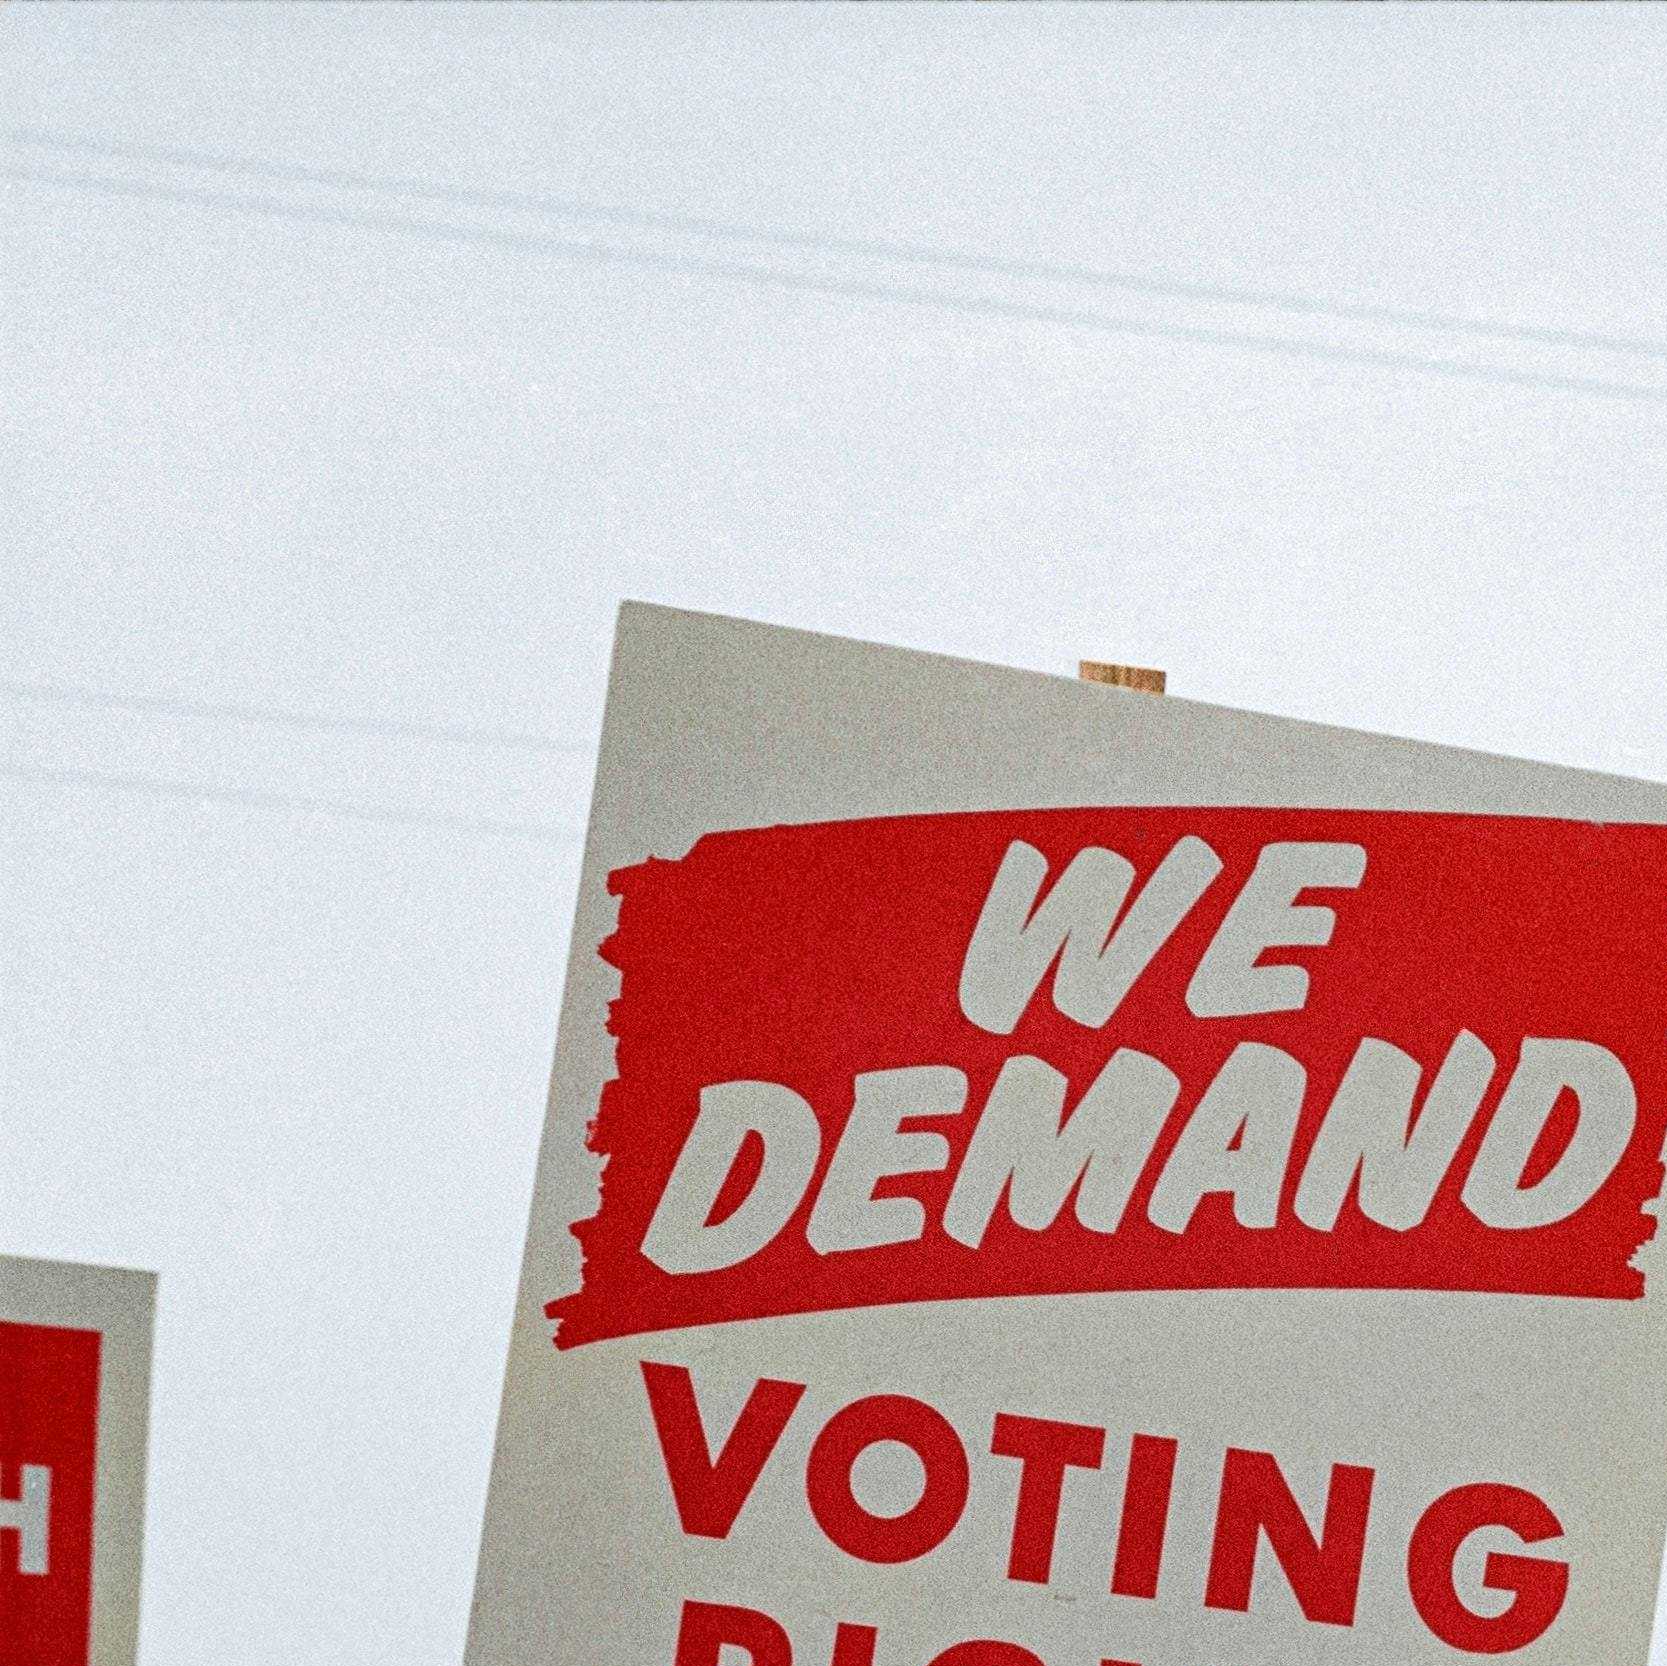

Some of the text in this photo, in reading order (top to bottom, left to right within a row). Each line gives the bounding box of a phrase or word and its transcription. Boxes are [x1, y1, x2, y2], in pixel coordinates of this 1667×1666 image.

[957, 834, 1368, 1036] WE
[639, 1030, 1638, 1276] DEMAND
[639, 1360, 1570, 1655] VOTING
